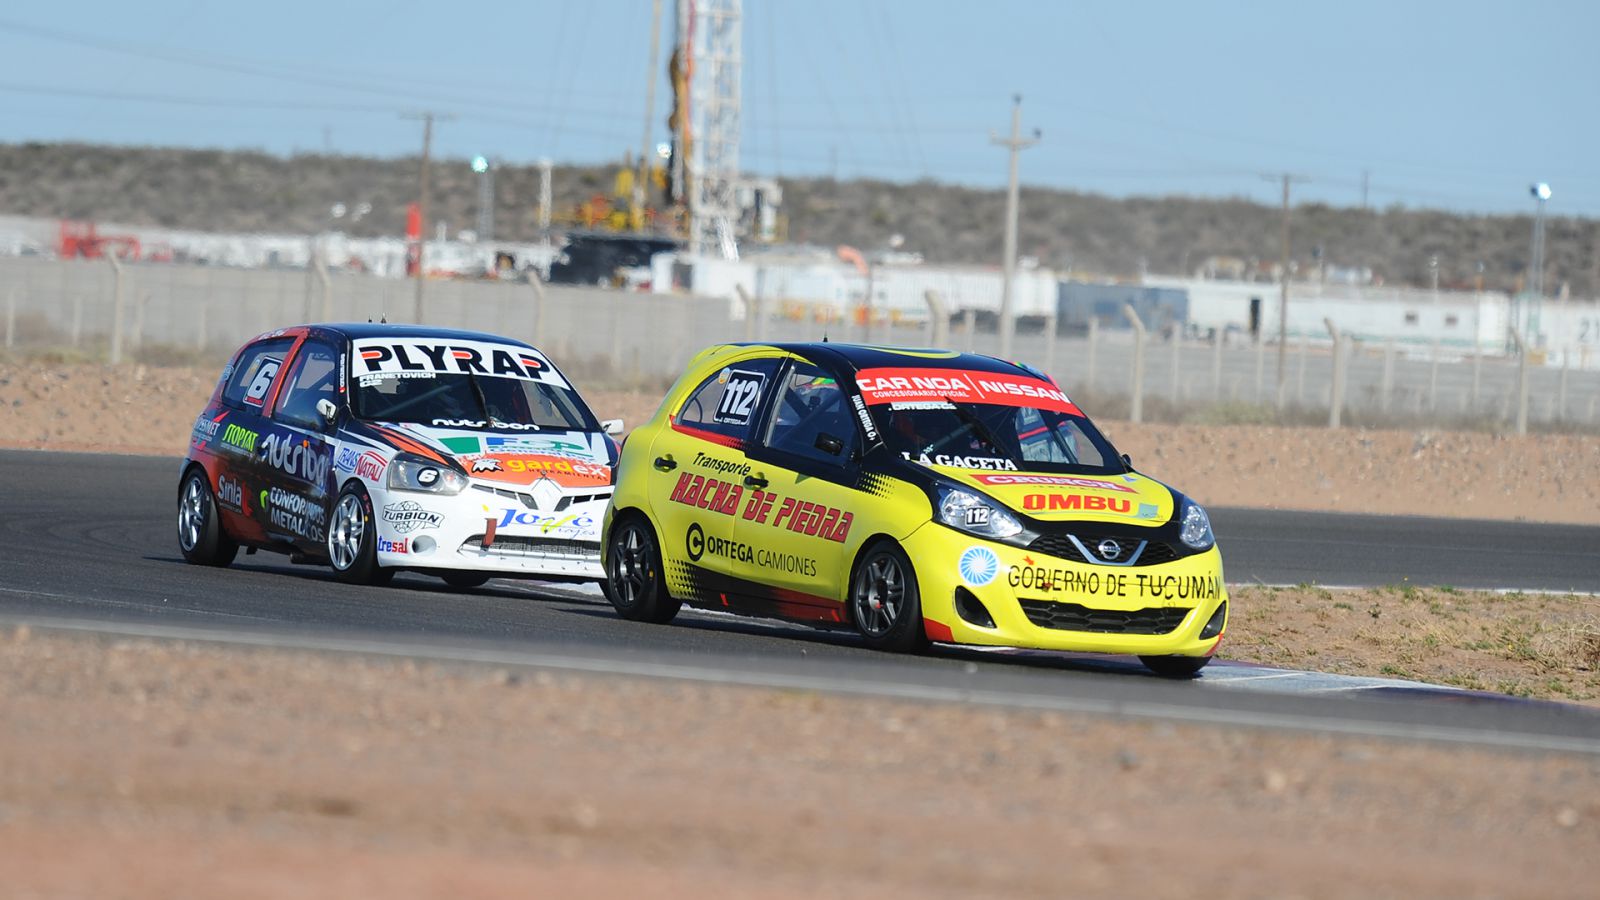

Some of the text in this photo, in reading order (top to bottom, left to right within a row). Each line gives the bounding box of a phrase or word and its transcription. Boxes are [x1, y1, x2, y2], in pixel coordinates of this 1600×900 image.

[359, 344, 551, 379] PLYRAP
[247, 362, 279, 400] 6
[856, 377, 1071, 404] CAR NOA NISSAN
[721, 378, 759, 416] 112
[872, 390, 970, 398] CONCESIONARIO OFICIAL
[851, 394, 865, 410] JUAN
[858, 409, 874, 432] ORTEGA
[506, 459, 606, 477] gardex
[692, 452, 751, 477] Transporte
[935, 454, 1018, 471] GACETA
[418, 469, 438, 483] 6
[670, 472, 855, 544] HACHA DE PIEDRA
[966, 508, 988, 524] 112
[1023, 494, 1131, 513] OMBU
[384, 510, 440, 523] TURBION
[377, 536, 409, 554] tresal
[707, 536, 817, 577] ORTEGA CAMIONES
[1008, 564, 1221, 601] GOBIERNO DE TUCUMÁN
